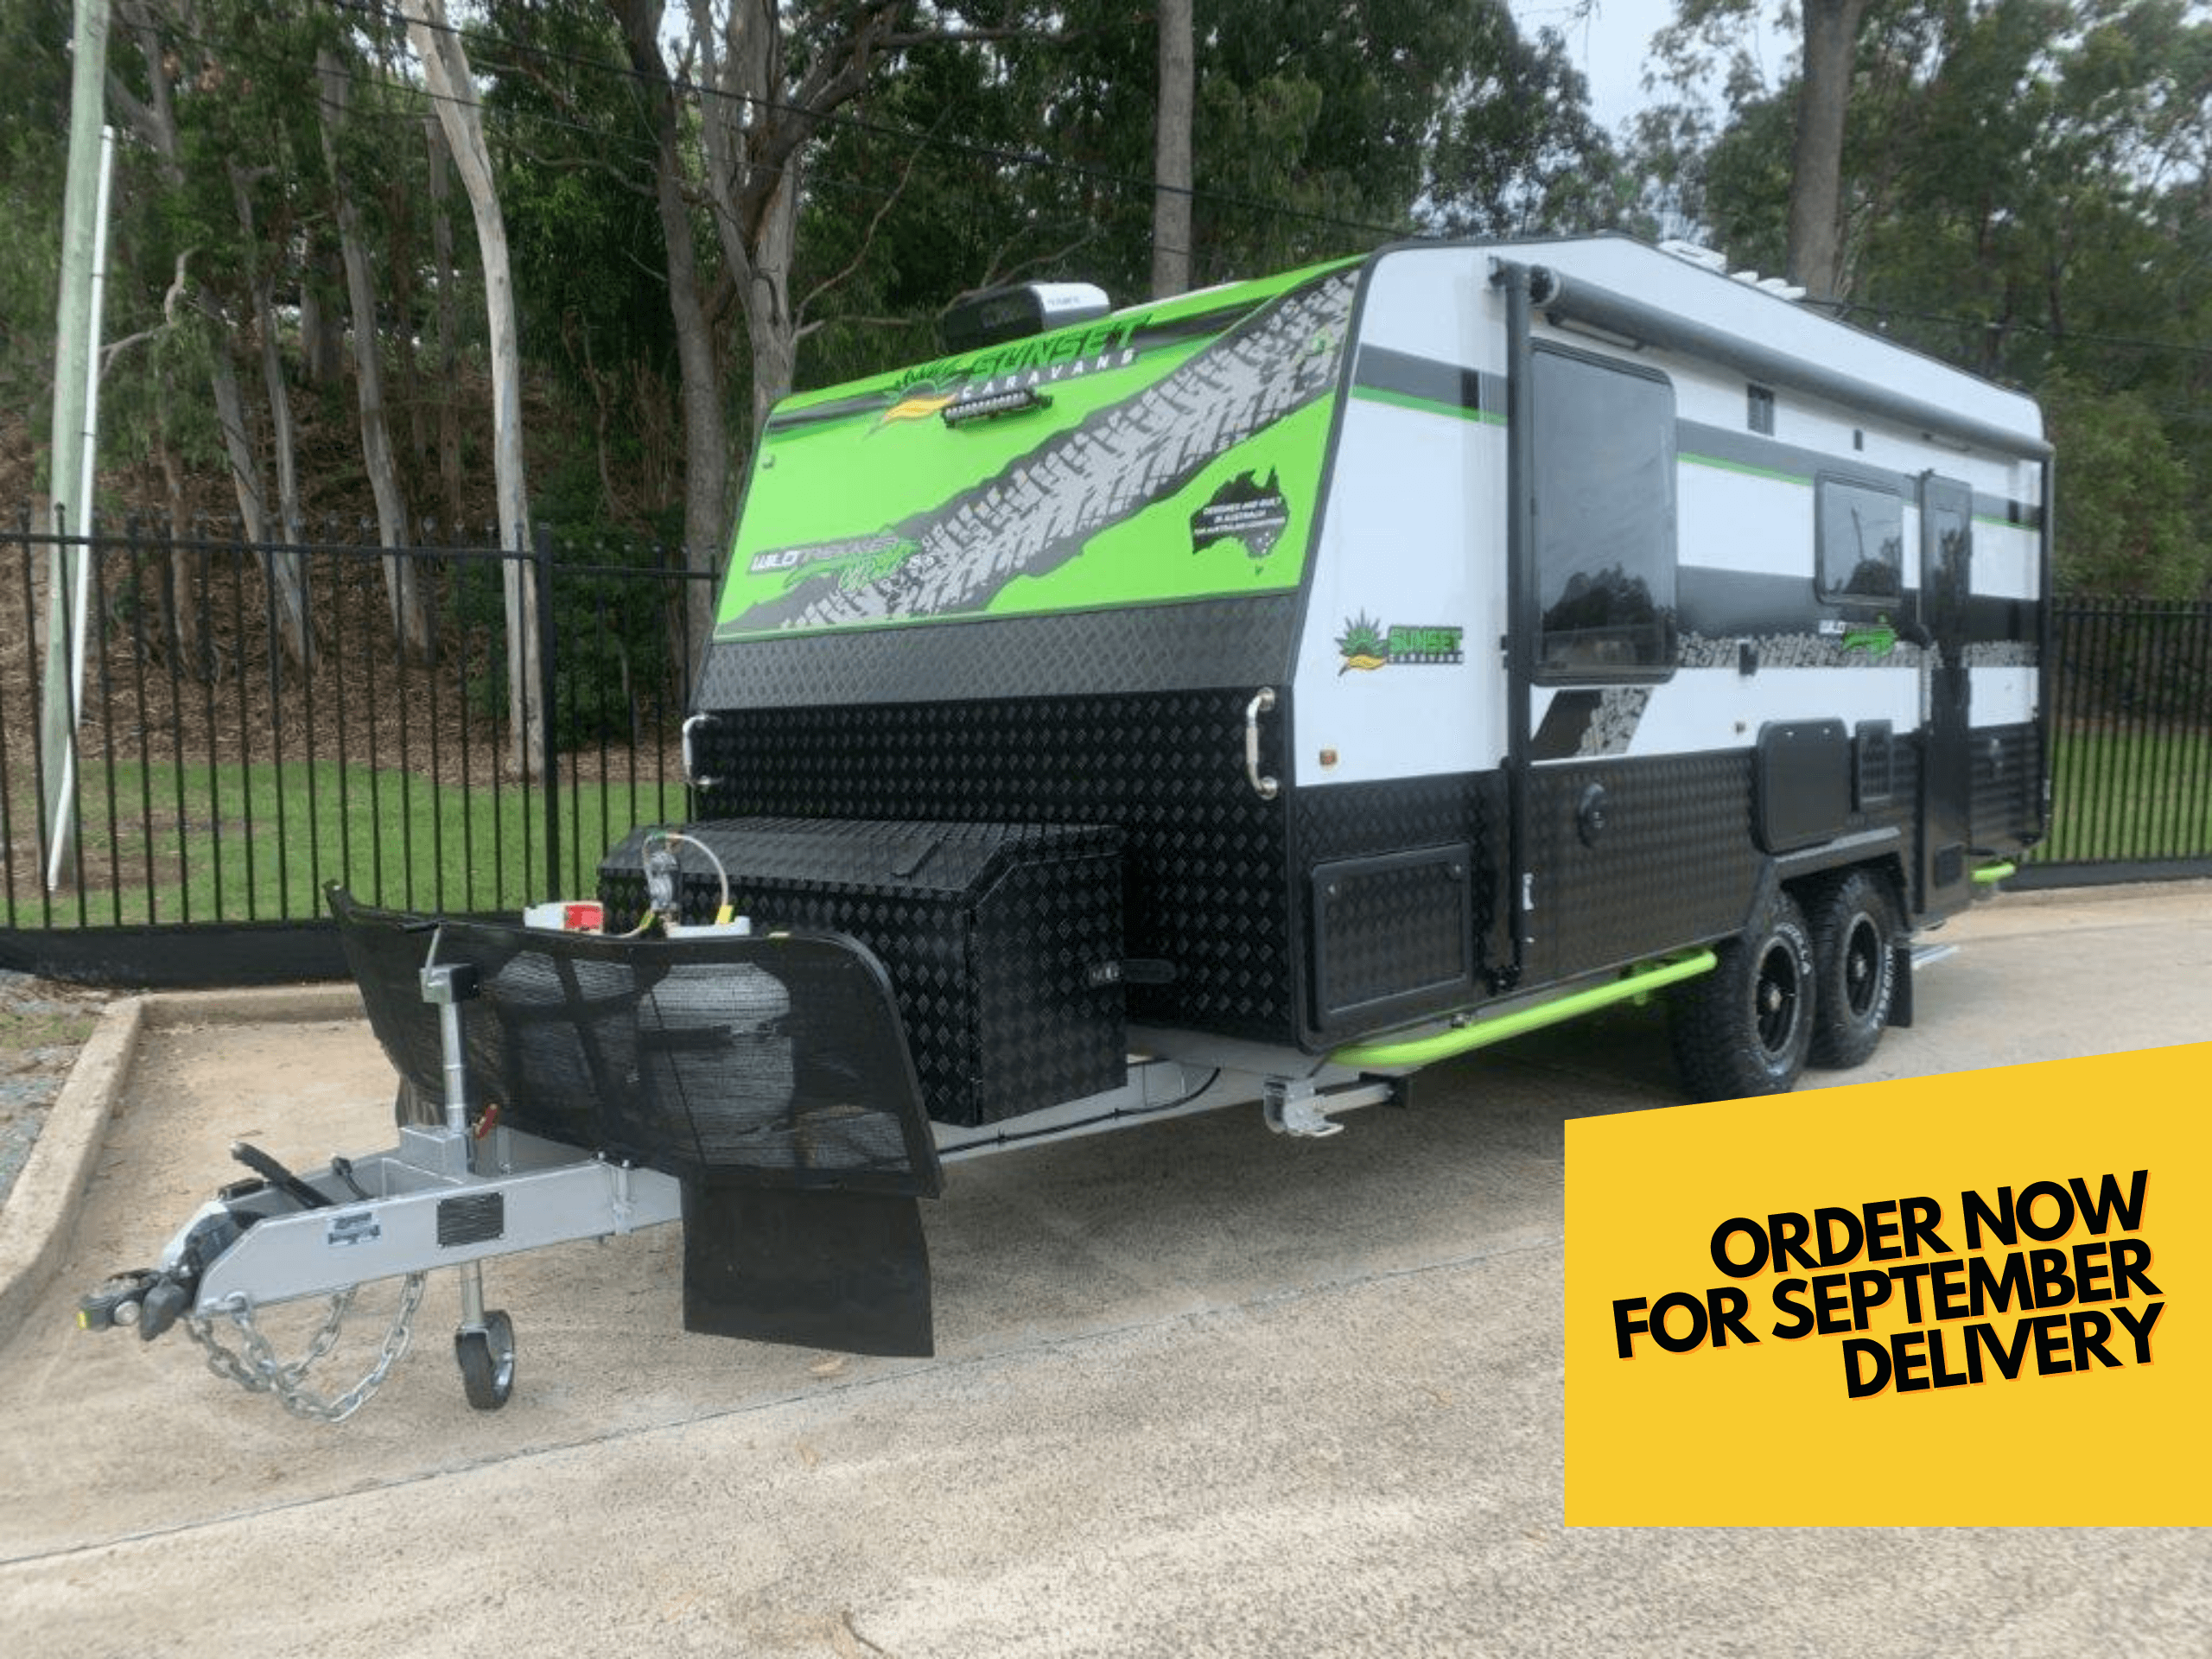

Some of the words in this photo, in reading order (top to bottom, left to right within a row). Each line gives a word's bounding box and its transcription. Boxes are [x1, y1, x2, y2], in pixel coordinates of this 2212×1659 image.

[962, 347, 1135, 401] CARAVANS
[969, 313, 1153, 381] SUNSET
[1388, 625, 1464, 654] SUNSET
